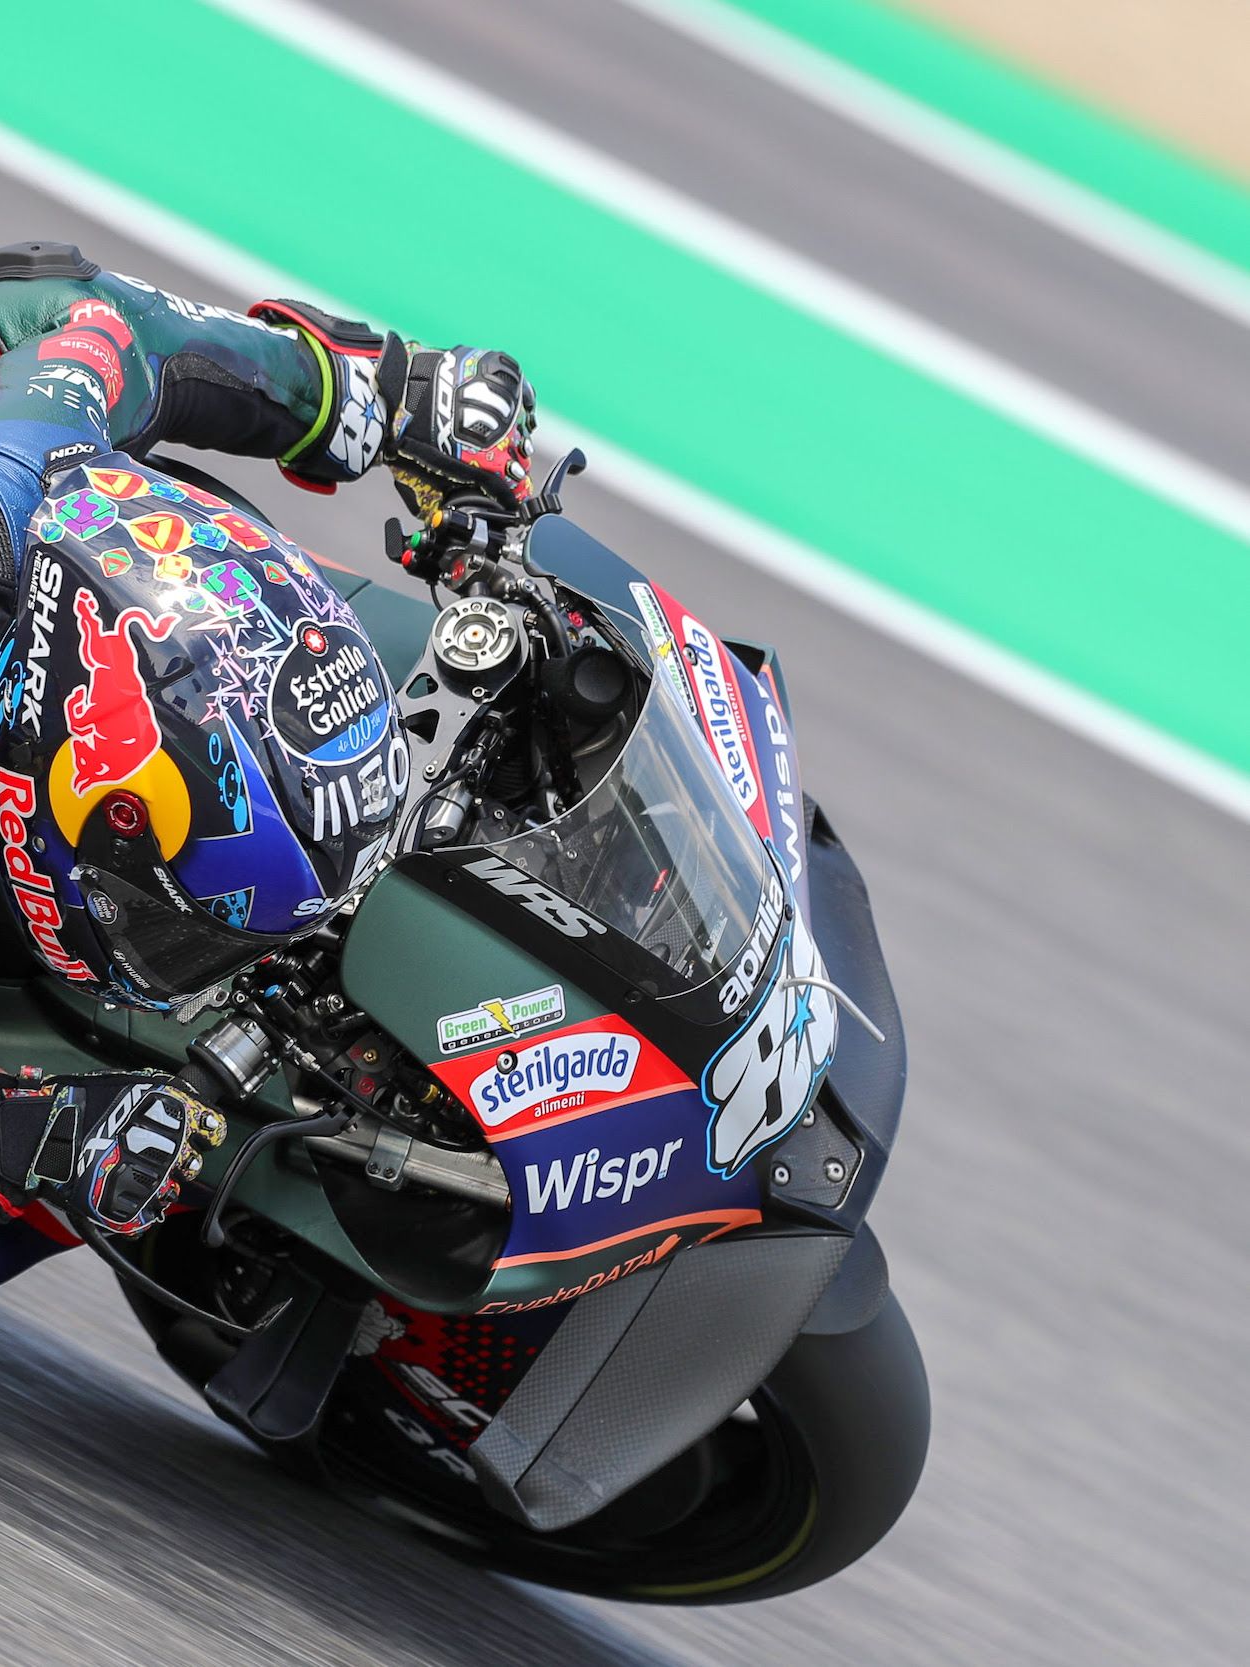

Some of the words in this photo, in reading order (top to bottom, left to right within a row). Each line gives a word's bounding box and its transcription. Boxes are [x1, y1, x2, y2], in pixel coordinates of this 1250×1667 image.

[28, 550, 43, 611] HELMETS
[21, 557, 63, 738] SHARK
[289, 644, 368, 711] Estrella
[308, 676, 380, 736] Galicia
[153, 865, 193, 915] SHARK
[462, 856, 608, 937] WRS
[12, 883, 100, 982] Bull
[719, 876, 784, 1014] aprilia
[444, 1014, 488, 1040] Green
[511, 995, 556, 1021] Power
[482, 1036, 630, 1112] sterilgarda
[534, 1092, 586, 1118] alimenti
[524, 1136, 684, 1215] Wispr
